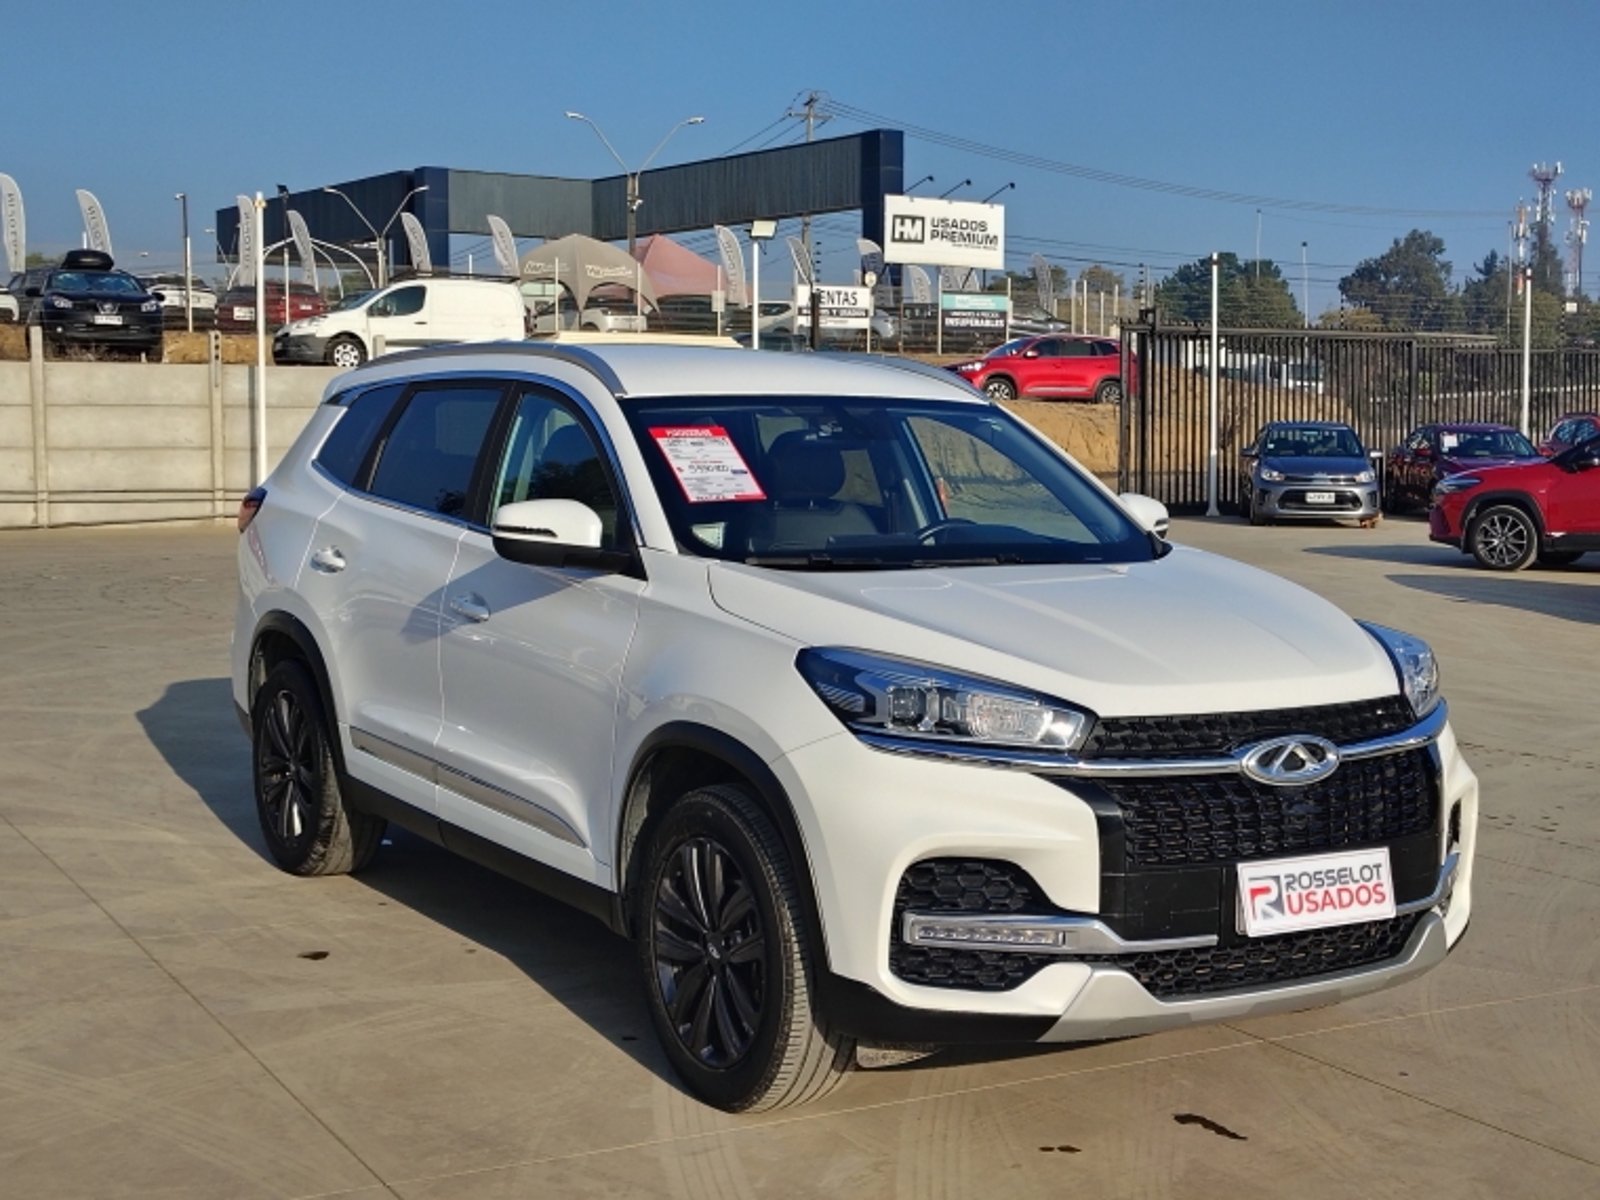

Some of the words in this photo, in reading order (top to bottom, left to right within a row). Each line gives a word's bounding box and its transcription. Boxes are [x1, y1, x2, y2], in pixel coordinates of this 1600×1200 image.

[892, 215, 925, 243] HM
[930, 217, 988, 232] USADOS
[930, 229, 999, 246] PREMIUM
[809, 289, 858, 305] ENTAS
[1284, 864, 1382, 892] ROSSELOT
[1286, 883, 1386, 916] USADOS
